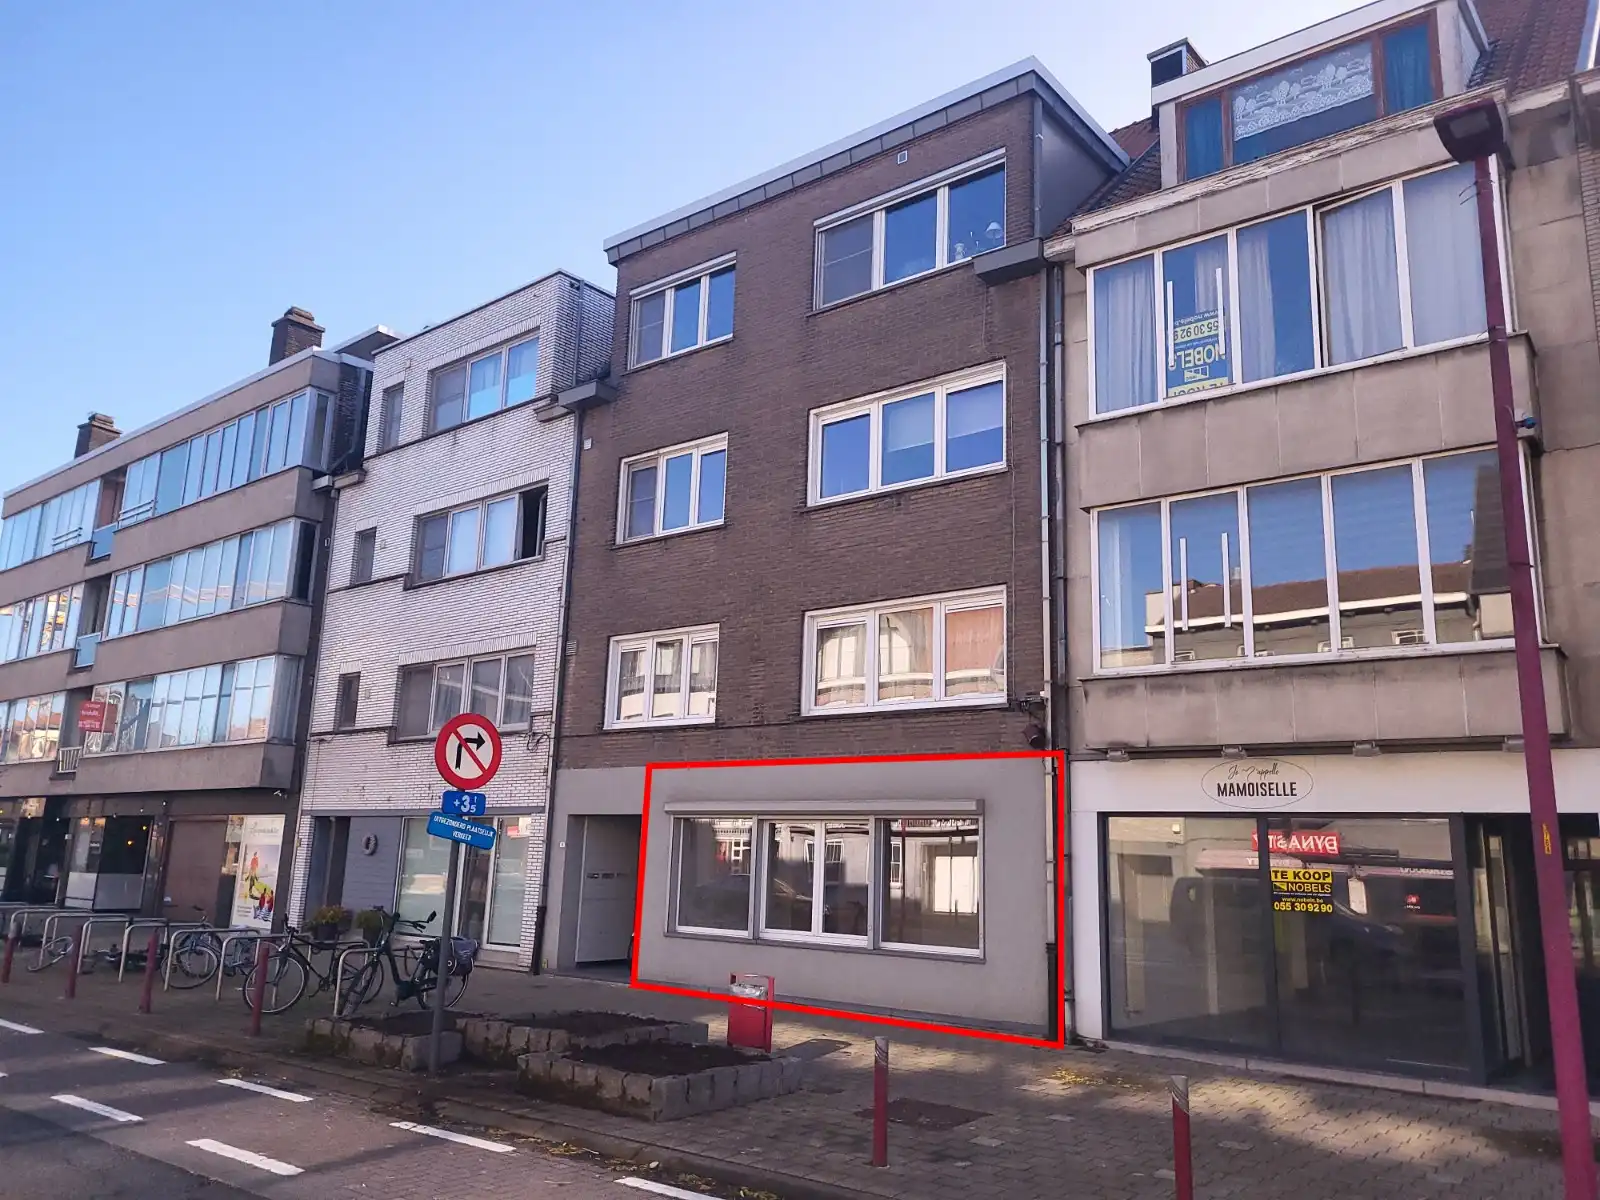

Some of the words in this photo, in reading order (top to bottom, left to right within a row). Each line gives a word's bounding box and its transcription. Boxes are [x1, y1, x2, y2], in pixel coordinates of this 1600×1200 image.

[1217, 782, 1297, 796] MAMOISELLE
[1272, 870, 1289, 880] TE
[1292, 870, 1331, 881] KOOP
[1288, 882, 1332, 893] NOBELS
[1273, 901, 1292, 911] 055
